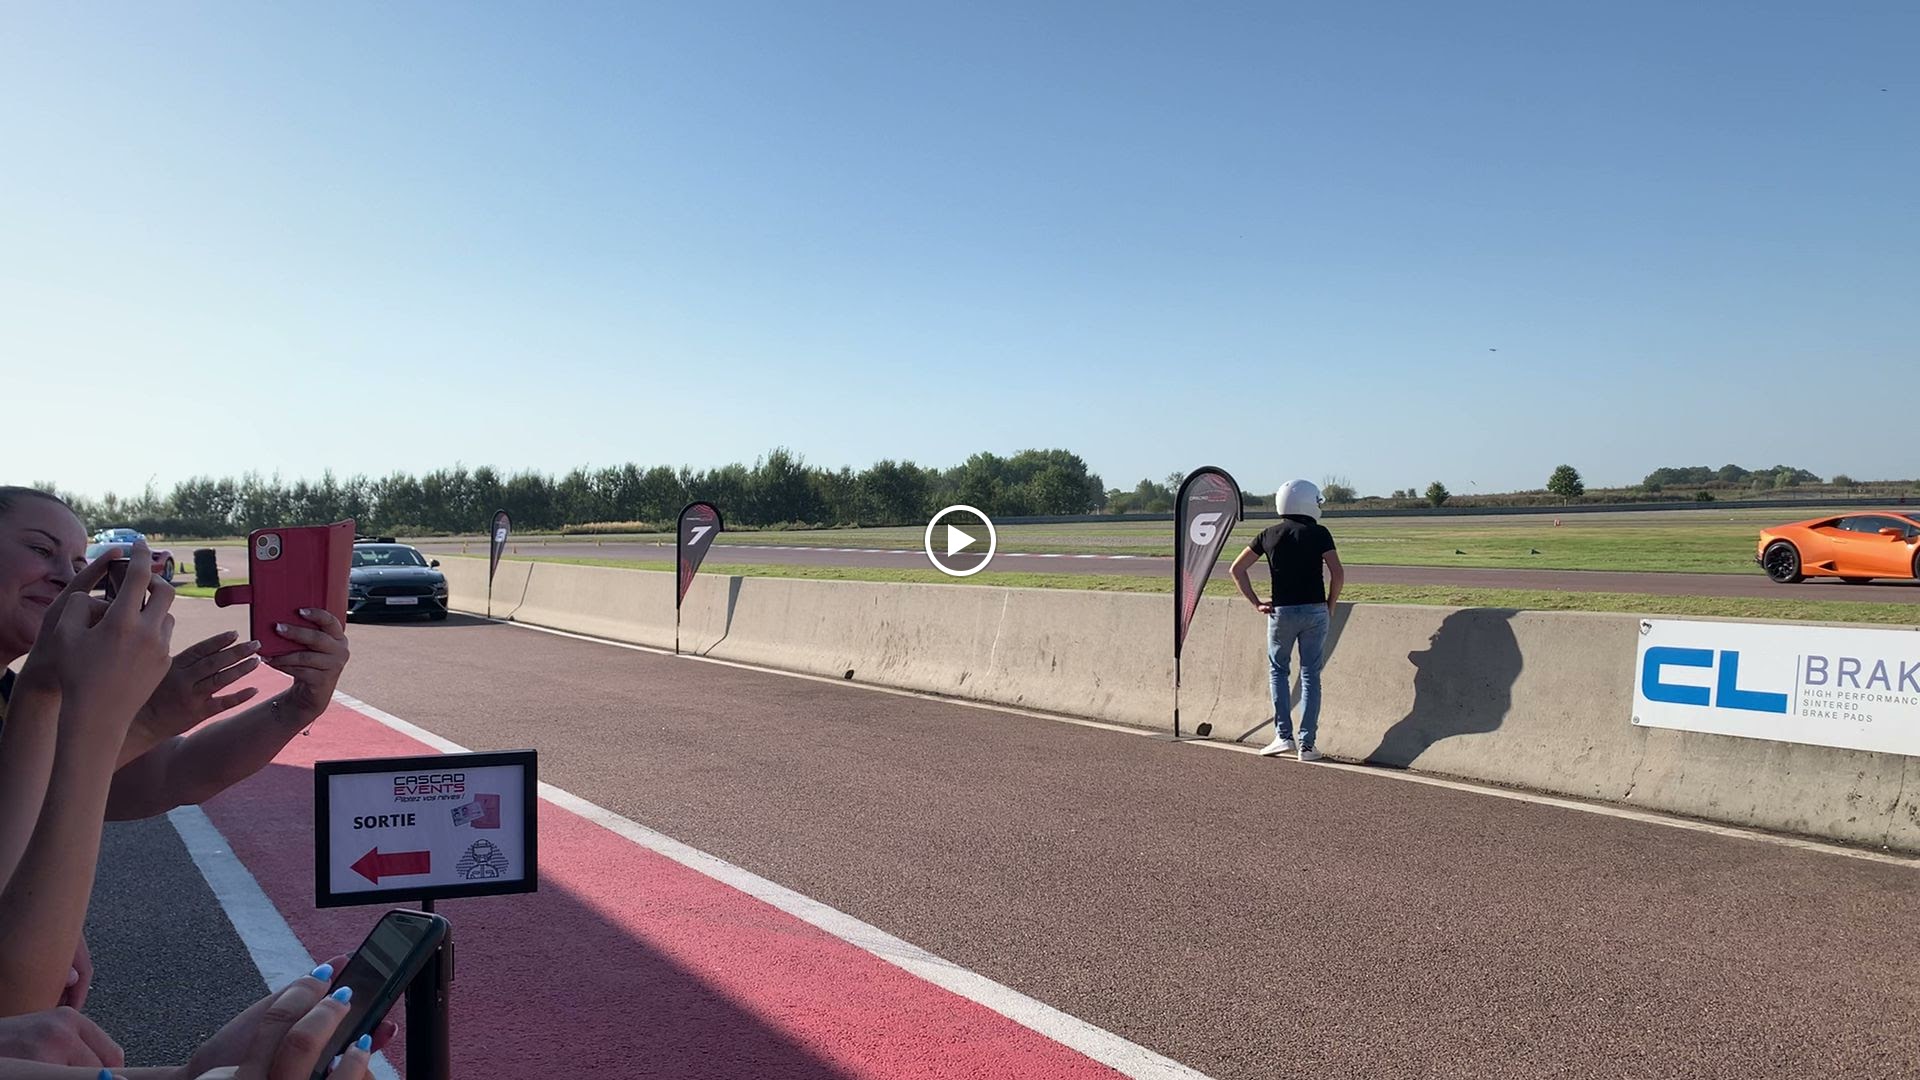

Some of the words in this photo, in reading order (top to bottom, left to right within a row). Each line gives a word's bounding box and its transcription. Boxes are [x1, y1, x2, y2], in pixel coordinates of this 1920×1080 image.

[687, 525, 712, 545] 7
[1189, 512, 1222, 545] 6
[1642, 646, 1788, 714] CL
[1803, 689, 1832, 698] HIGH
[1803, 699, 1859, 711] SINTERED
[1802, 709, 1838, 719] BRAKE
[1843, 712, 1873, 723] PADS
[394, 773, 465, 786] CASCAD
[394, 783, 465, 796] EVENTS
[353, 813, 416, 830] SORTIE
